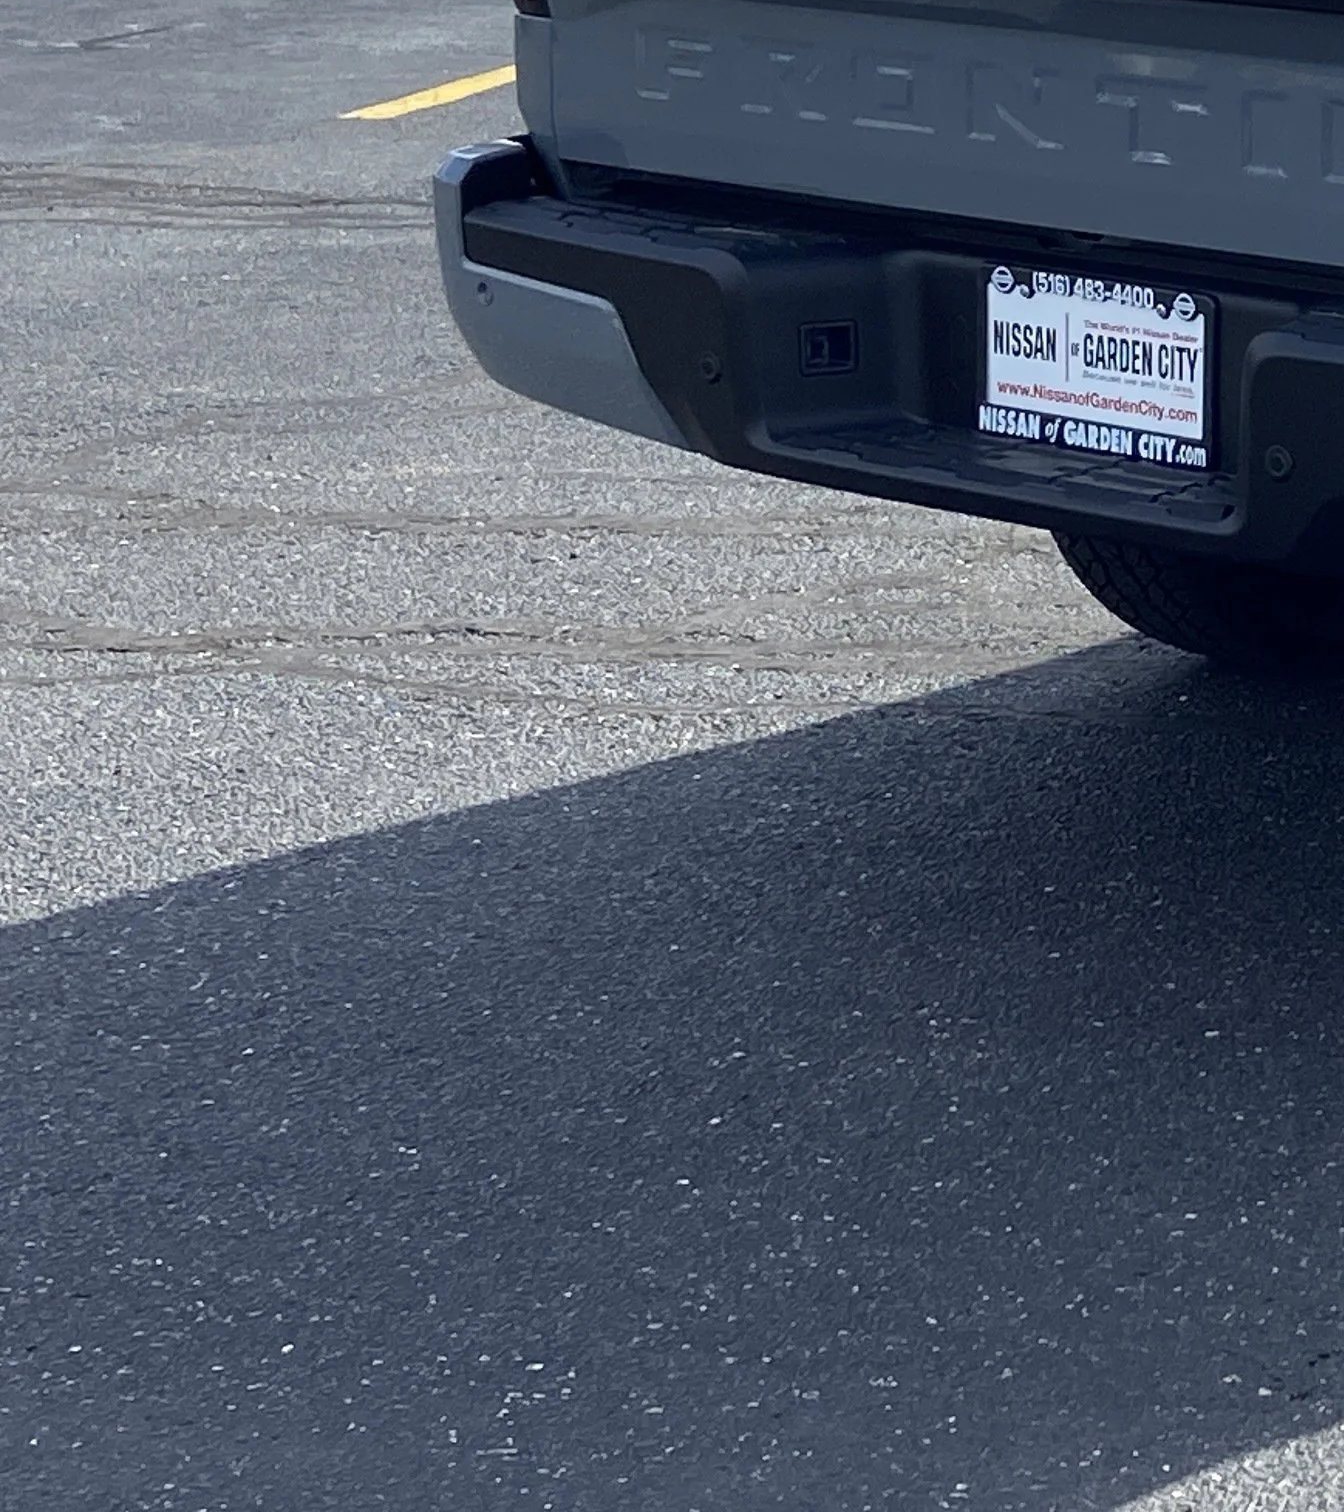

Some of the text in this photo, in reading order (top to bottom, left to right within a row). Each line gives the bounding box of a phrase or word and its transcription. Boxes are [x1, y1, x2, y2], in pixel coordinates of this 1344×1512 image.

[1031, 271, 1155, 308] (516) 483-4400
[993, 319, 1057, 363] NISSAN
[1070, 333, 1199, 383] OF GARDEN CITY
[997, 381, 1198, 424] www.NissanofGardenCity.com
[978, 405, 1207, 468] NISSAN of GARDEN CITY.com
